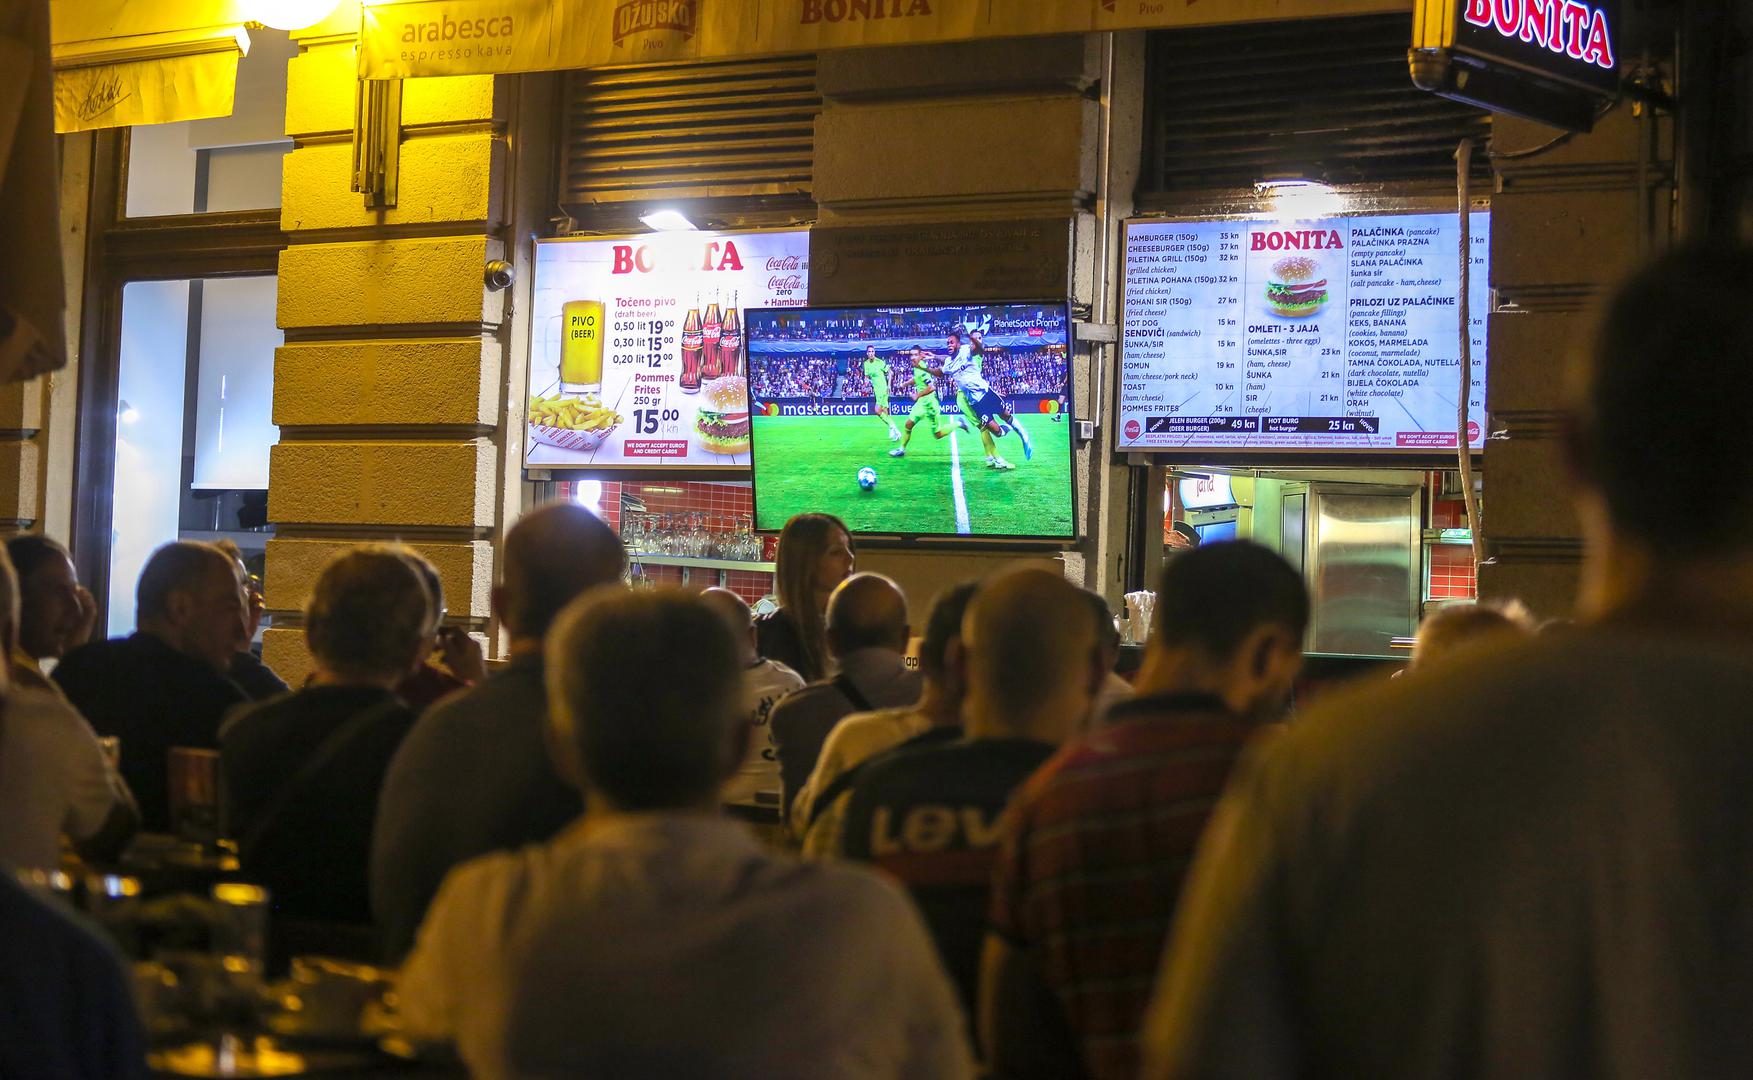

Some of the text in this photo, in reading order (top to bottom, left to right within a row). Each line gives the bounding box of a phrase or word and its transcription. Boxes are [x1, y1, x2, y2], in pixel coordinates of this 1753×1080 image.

[402, 15, 513, 43] arabesca
[644, 39, 663, 49] Pivo
[401, 45, 512, 62] espresso kava
[1352, 227, 1439, 237] PALAČINKA (pancake)
[1251, 230, 1344, 251] BONITA
[1352, 238, 1395, 247] PALAČINKA
[1379, 258, 1423, 266] PALAČINKA
[616, 298, 675, 307] Točeno pivo
[1403, 296, 1454, 305] PALAČINKE
[572, 316, 594, 326] PIVO
[614, 322, 634, 331] 0,50
[571, 330, 594, 340] (BEER)
[1125, 328, 1164, 337] SENDVIČI
[614, 338, 634, 348] 0,30
[613, 355, 633, 364] 0,20
[1377, 358, 1422, 366] ČOKOLADA,
[635, 373, 674, 383] Pommes
[634, 386, 660, 394] Frites
[784, 402, 868, 415] mastercard
[1245, 420, 1255, 428] kn
[1329, 421, 1354, 430] 25 kn
